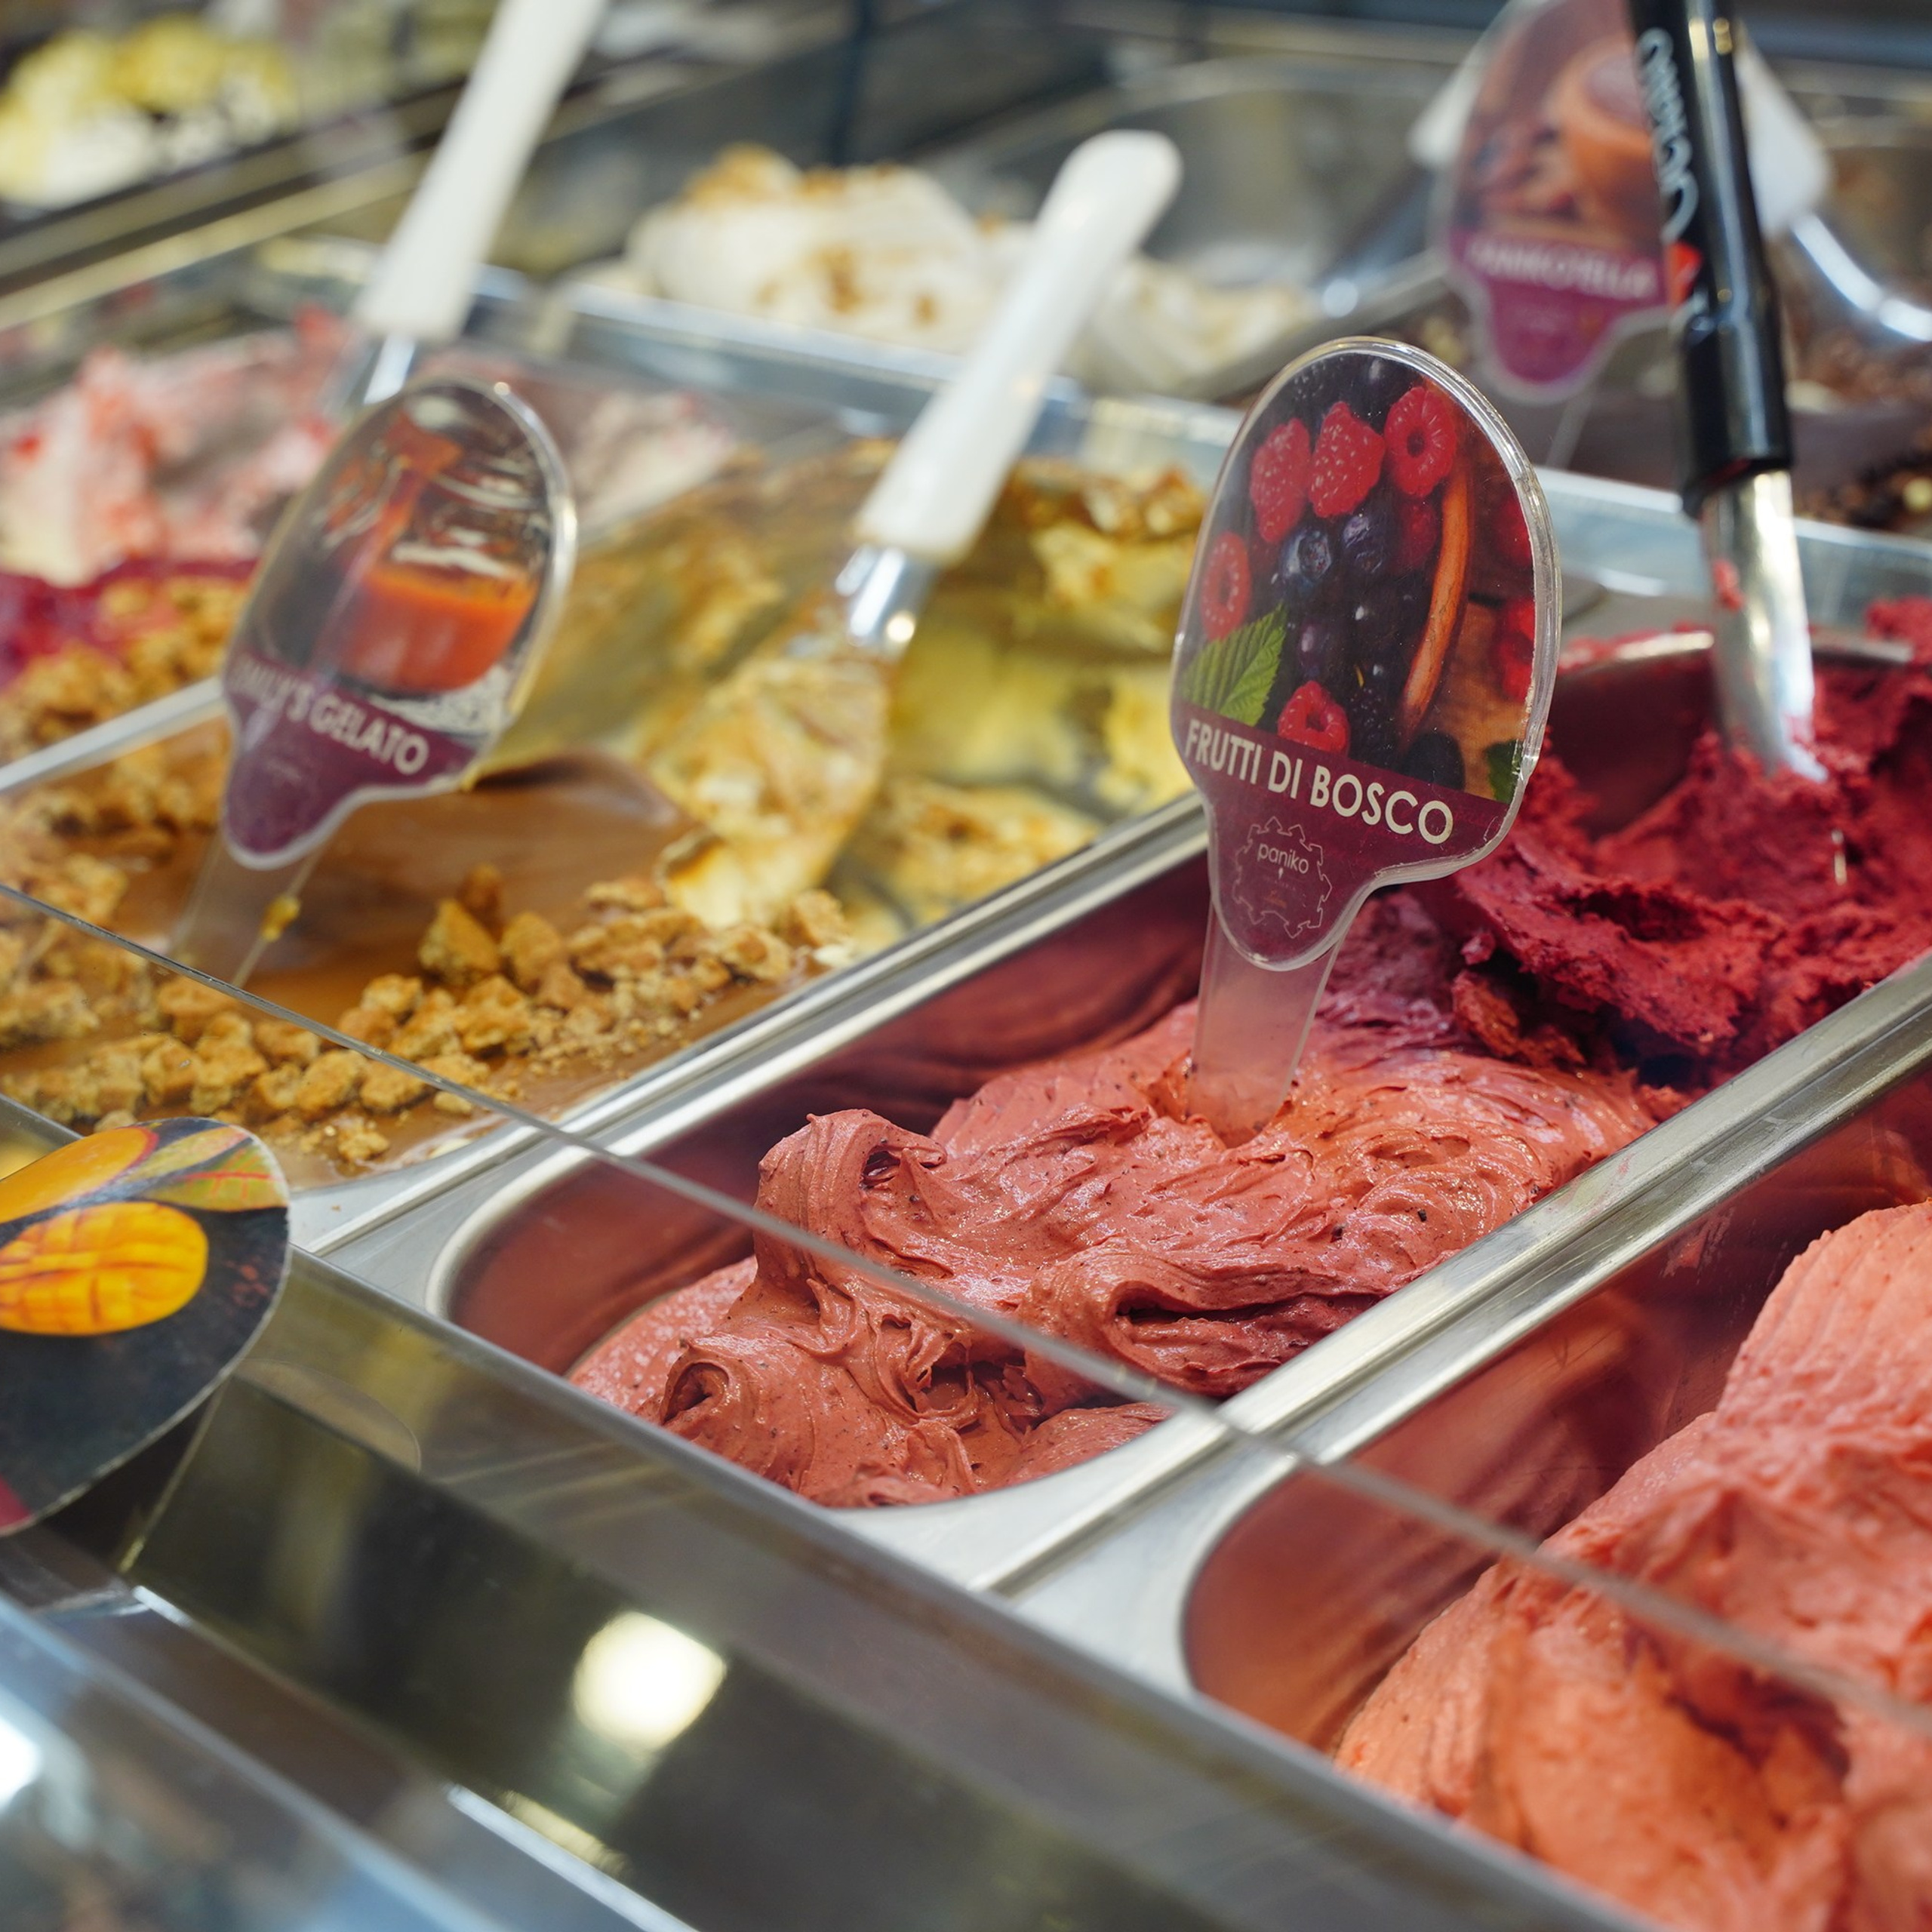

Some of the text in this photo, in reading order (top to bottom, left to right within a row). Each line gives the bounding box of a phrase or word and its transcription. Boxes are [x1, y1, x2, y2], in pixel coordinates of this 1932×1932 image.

[309, 693, 429, 774] GELATO
[1185, 719, 1454, 844] FRUTTI DI BOSCO
[1257, 841, 1309, 874] paniko
